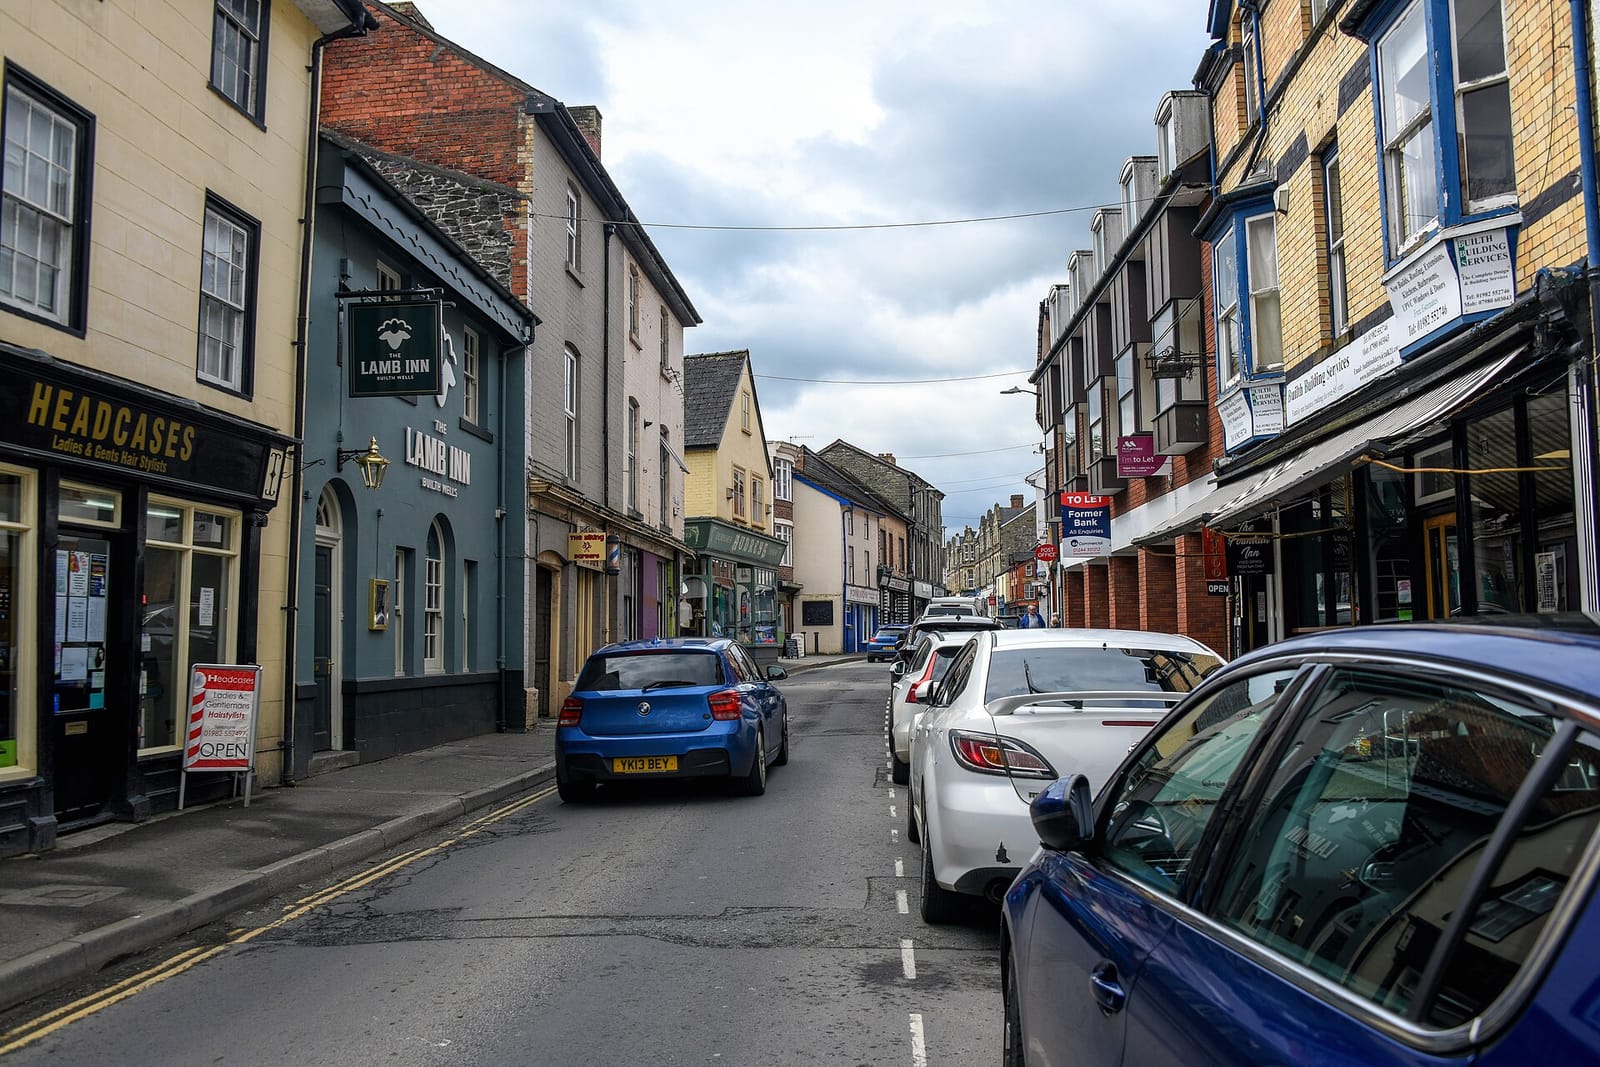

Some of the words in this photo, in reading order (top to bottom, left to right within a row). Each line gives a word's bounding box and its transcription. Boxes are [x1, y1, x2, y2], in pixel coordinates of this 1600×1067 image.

[1458, 234, 1493, 247] BUILTH
[1459, 242, 1506, 257] BUILDING
[1460, 252, 1509, 267] SERVICES
[1472, 271, 1493, 280] Complete
[1433, 281, 1446, 292] Doors
[361, 360, 401, 375] LAMB
[405, 359, 430, 373] INN
[1288, 383, 1303, 403] Builth
[1304, 371, 1326, 394] Building
[1326, 356, 1350, 380] Services
[27, 382, 195, 461] HEADCASES
[434, 419, 447, 435] THE
[52, 434, 83, 455] Ladies
[85, 442, 92, 457] &
[94, 444, 119, 462] Gents
[121, 451, 138, 466] Hair
[139, 455, 168, 473] Stylists
[406, 426, 447, 476] LAMB
[449, 445, 471, 485] INN
[442, 484, 458, 497] WELLS
[1067, 495, 1081, 504] TO
[1084, 495, 1103, 503] LET
[1068, 510, 1103, 518] Former
[1074, 518, 1098, 527] Bank
[1241, 546, 1260, 559] Inn
[208, 674, 254, 685] Headcases
[213, 691, 237, 699] Ladies
[205, 700, 250, 709] Gentlemans
[208, 711, 245, 720] Hairstylists
[201, 742, 247, 758] OPEN
[621, 759, 645, 770] YK13
[648, 758, 669, 769] BEY
